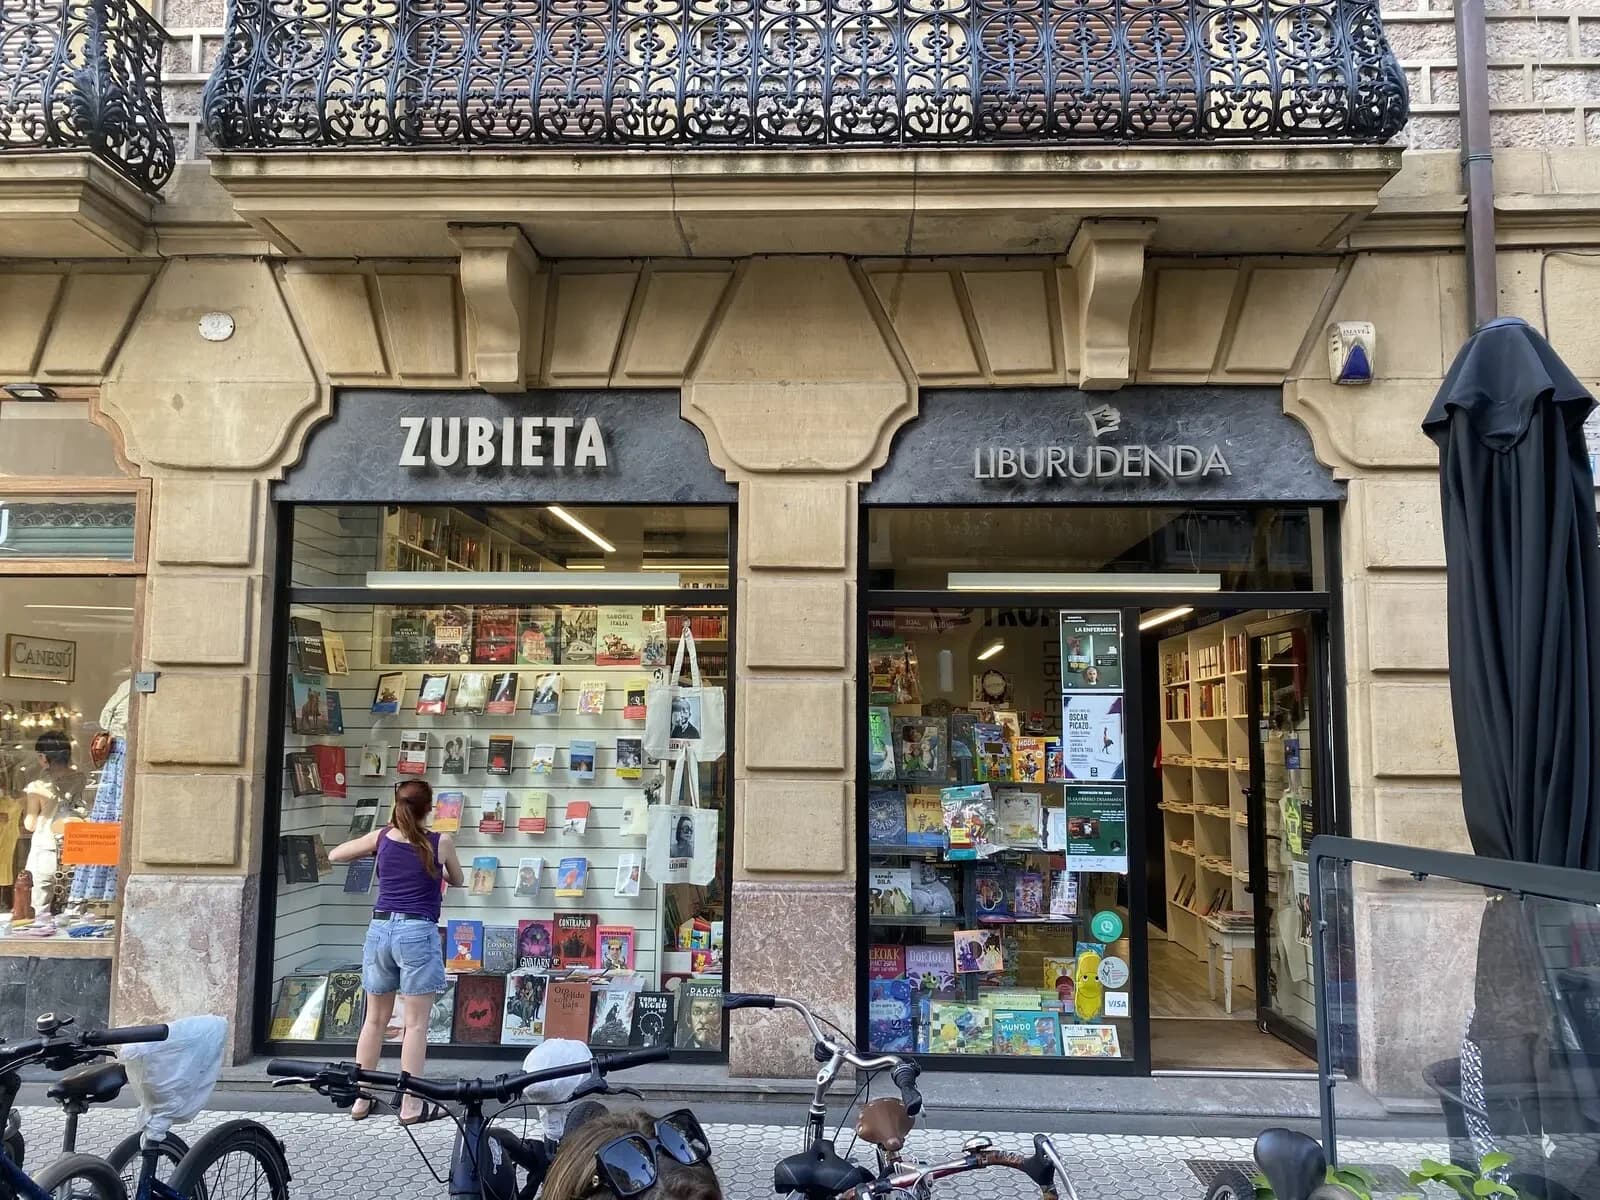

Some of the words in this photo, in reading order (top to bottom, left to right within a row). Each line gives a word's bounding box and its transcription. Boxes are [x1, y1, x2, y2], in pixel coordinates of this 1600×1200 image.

[399, 416, 608, 467] ZUBIETA
[974, 444, 1233, 479] LIBURUDENDA
[1068, 713, 1088, 721] OSCAR
[1069, 722, 1089, 730] PICAZO
[558, 918, 591, 927] CONTRAPASO
[554, 986, 570, 994] Oro
[690, 986, 722, 994] DAGÓN
[638, 1001, 668, 1009] NEGRO
[1108, 1000, 1127, 1008] VISA
[1001, 1022, 1031, 1032] MUNDO
